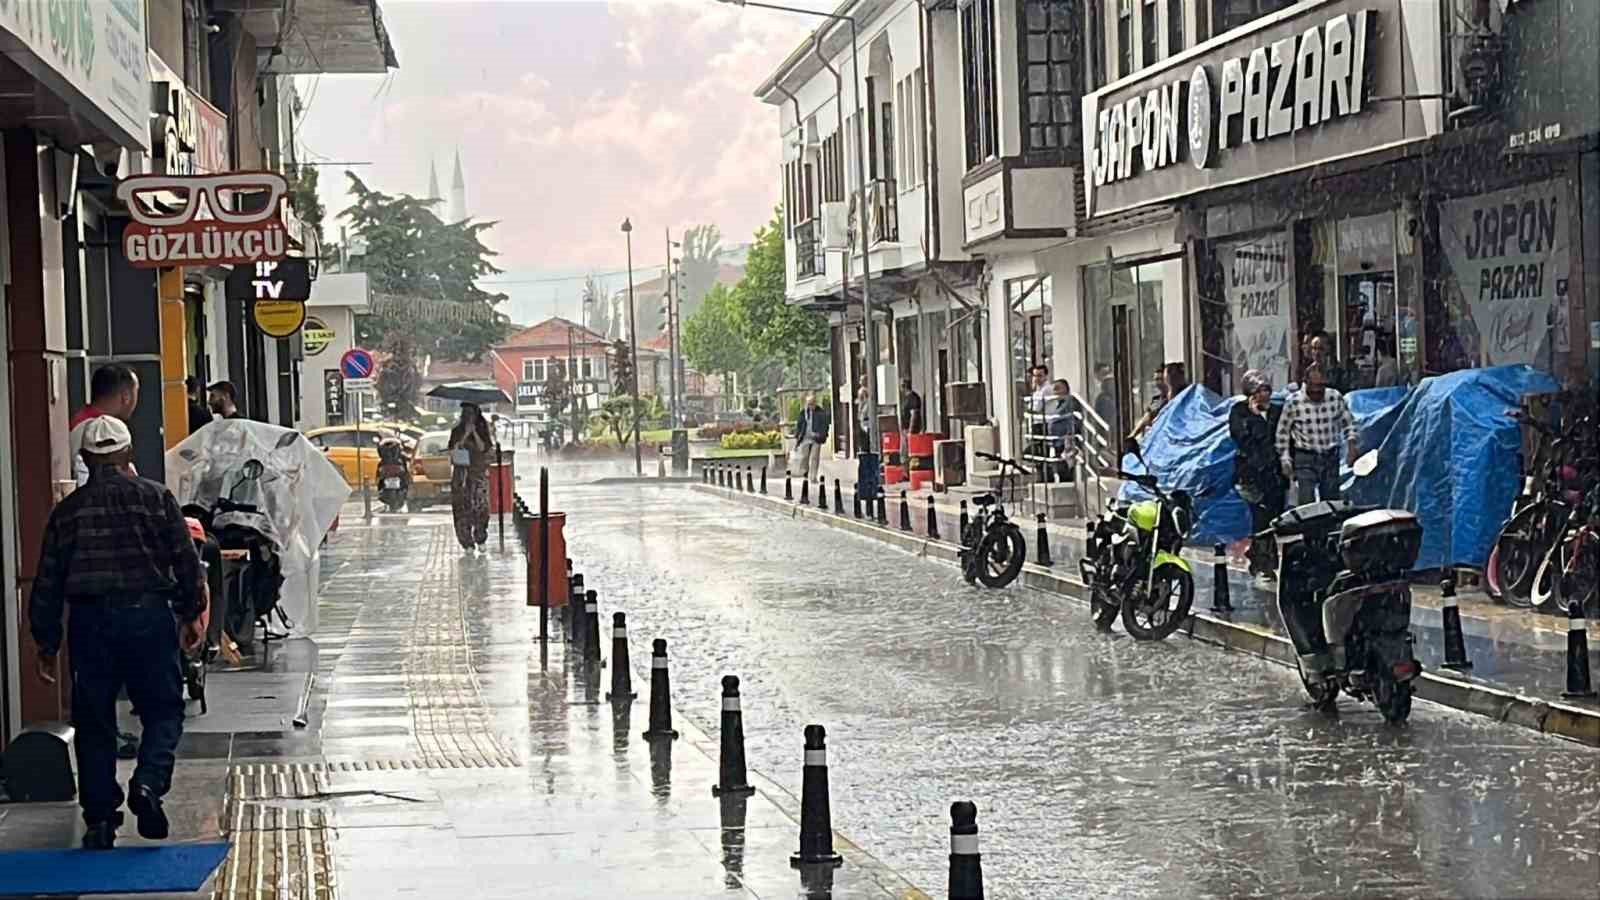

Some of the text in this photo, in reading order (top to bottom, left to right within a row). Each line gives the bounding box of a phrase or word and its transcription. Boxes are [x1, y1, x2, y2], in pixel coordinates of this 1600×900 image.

[1093, 80, 1180, 186] JAPON
[1219, 9, 1369, 149] PAZARI
[127, 224, 284, 261] GÖZLÜKÇÜ
[1465, 196, 1557, 260] JAPON
[255, 261, 278, 277] IP
[1231, 240, 1286, 288] JAPON
[1480, 262, 1544, 301] PAZARI
[251, 280, 284, 298] TV
[1240, 288, 1279, 318] PAZARI
